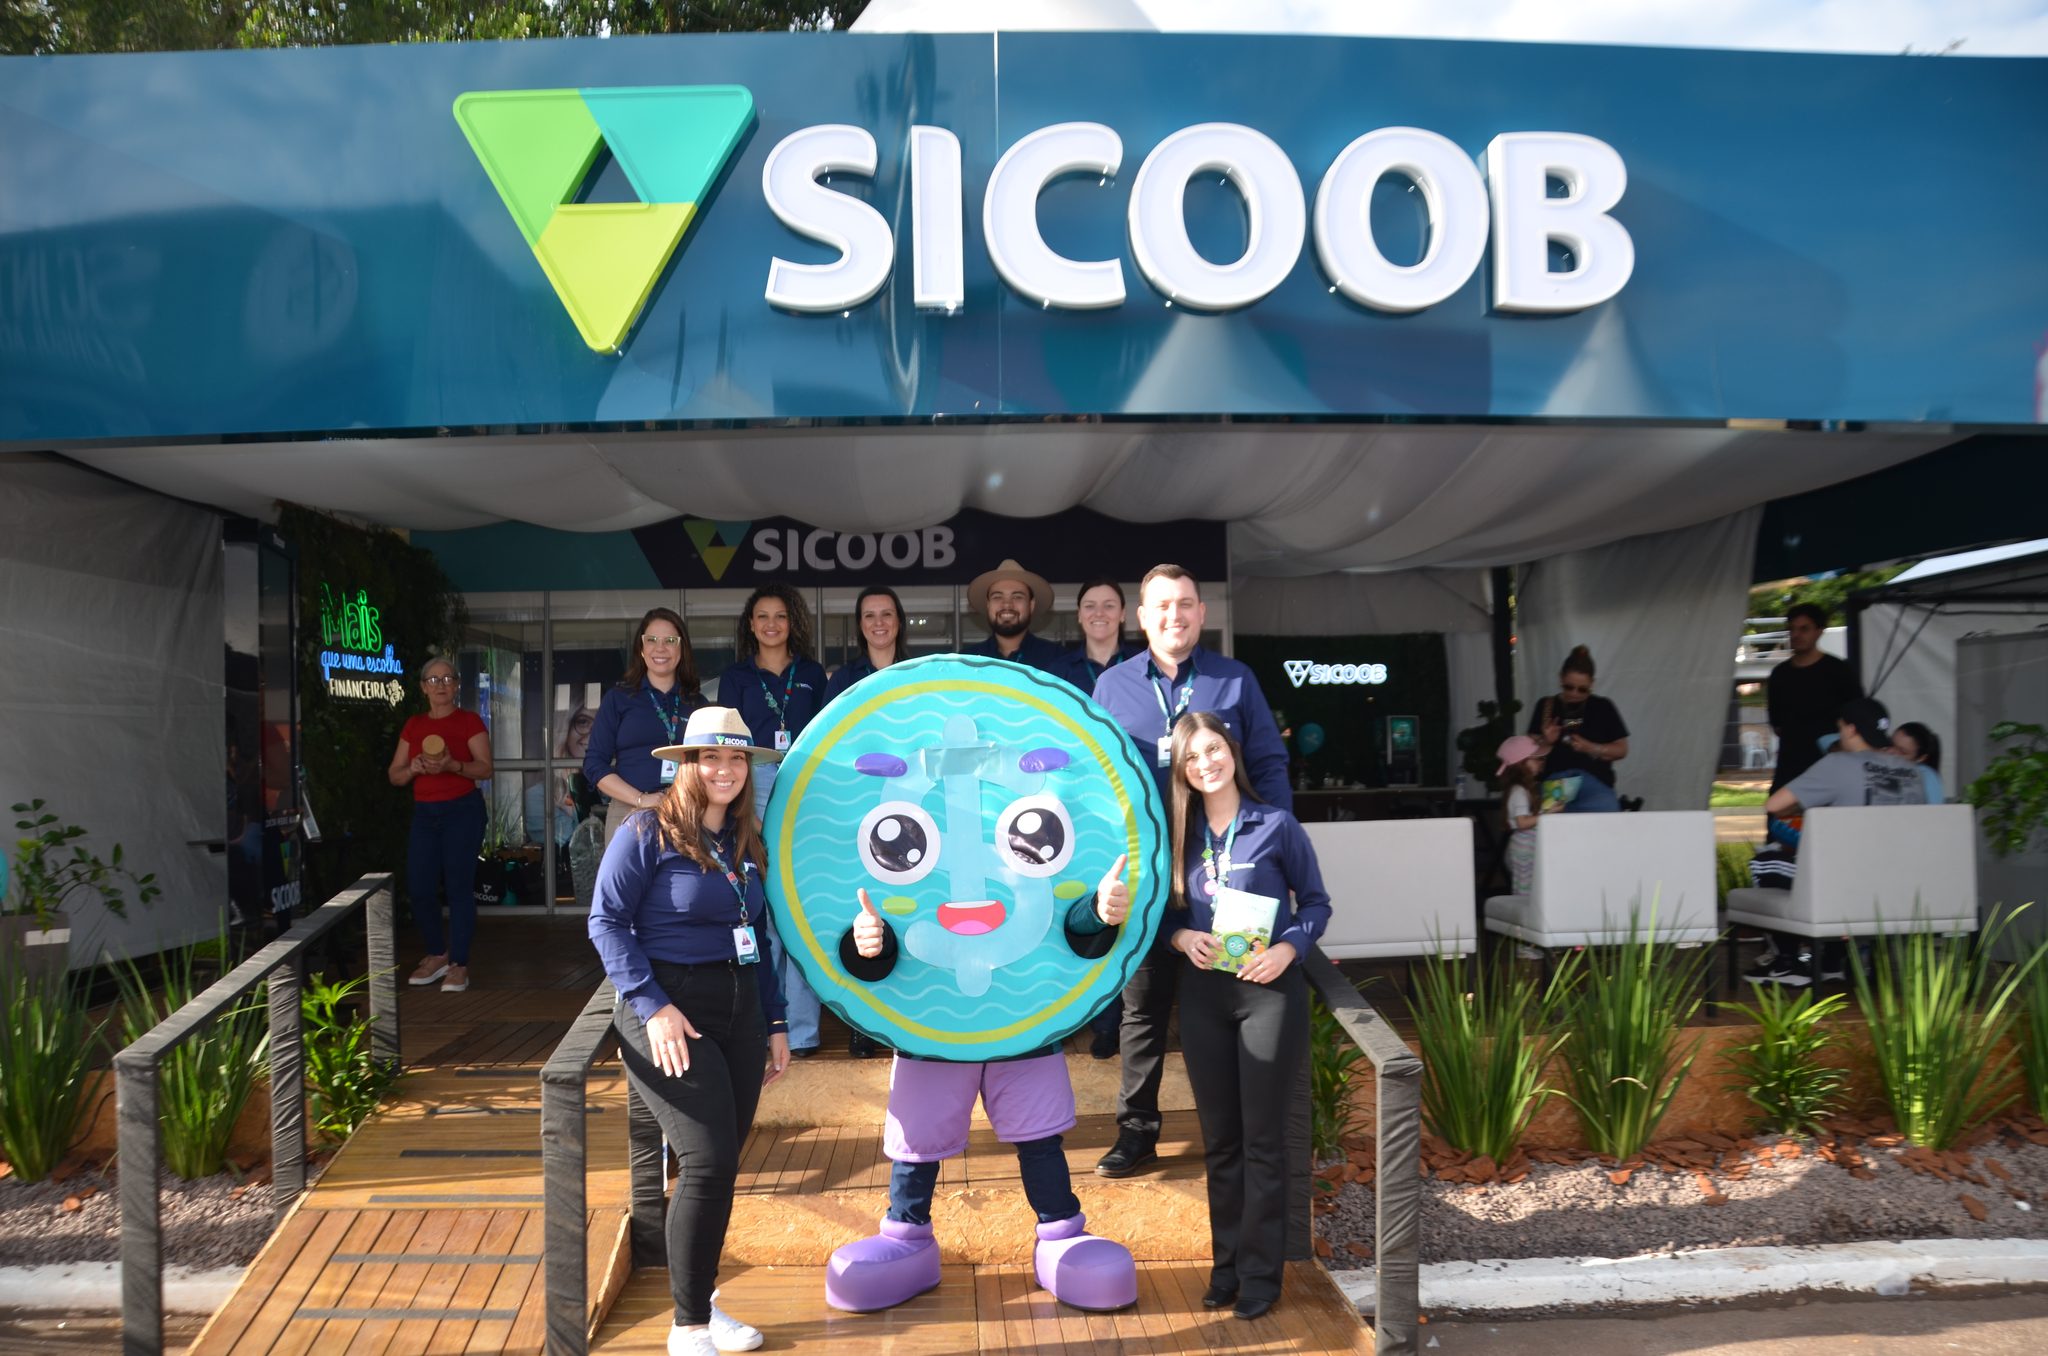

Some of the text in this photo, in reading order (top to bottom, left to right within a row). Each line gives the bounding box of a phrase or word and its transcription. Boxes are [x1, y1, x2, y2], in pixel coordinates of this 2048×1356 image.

[763, 121, 1636, 313] SICOOB
[753, 526, 957, 571] SICOOB
[320, 582, 382, 652] Mais
[321, 643, 404, 681] que uma escolha
[1308, 664, 1387, 684] SICOOB
